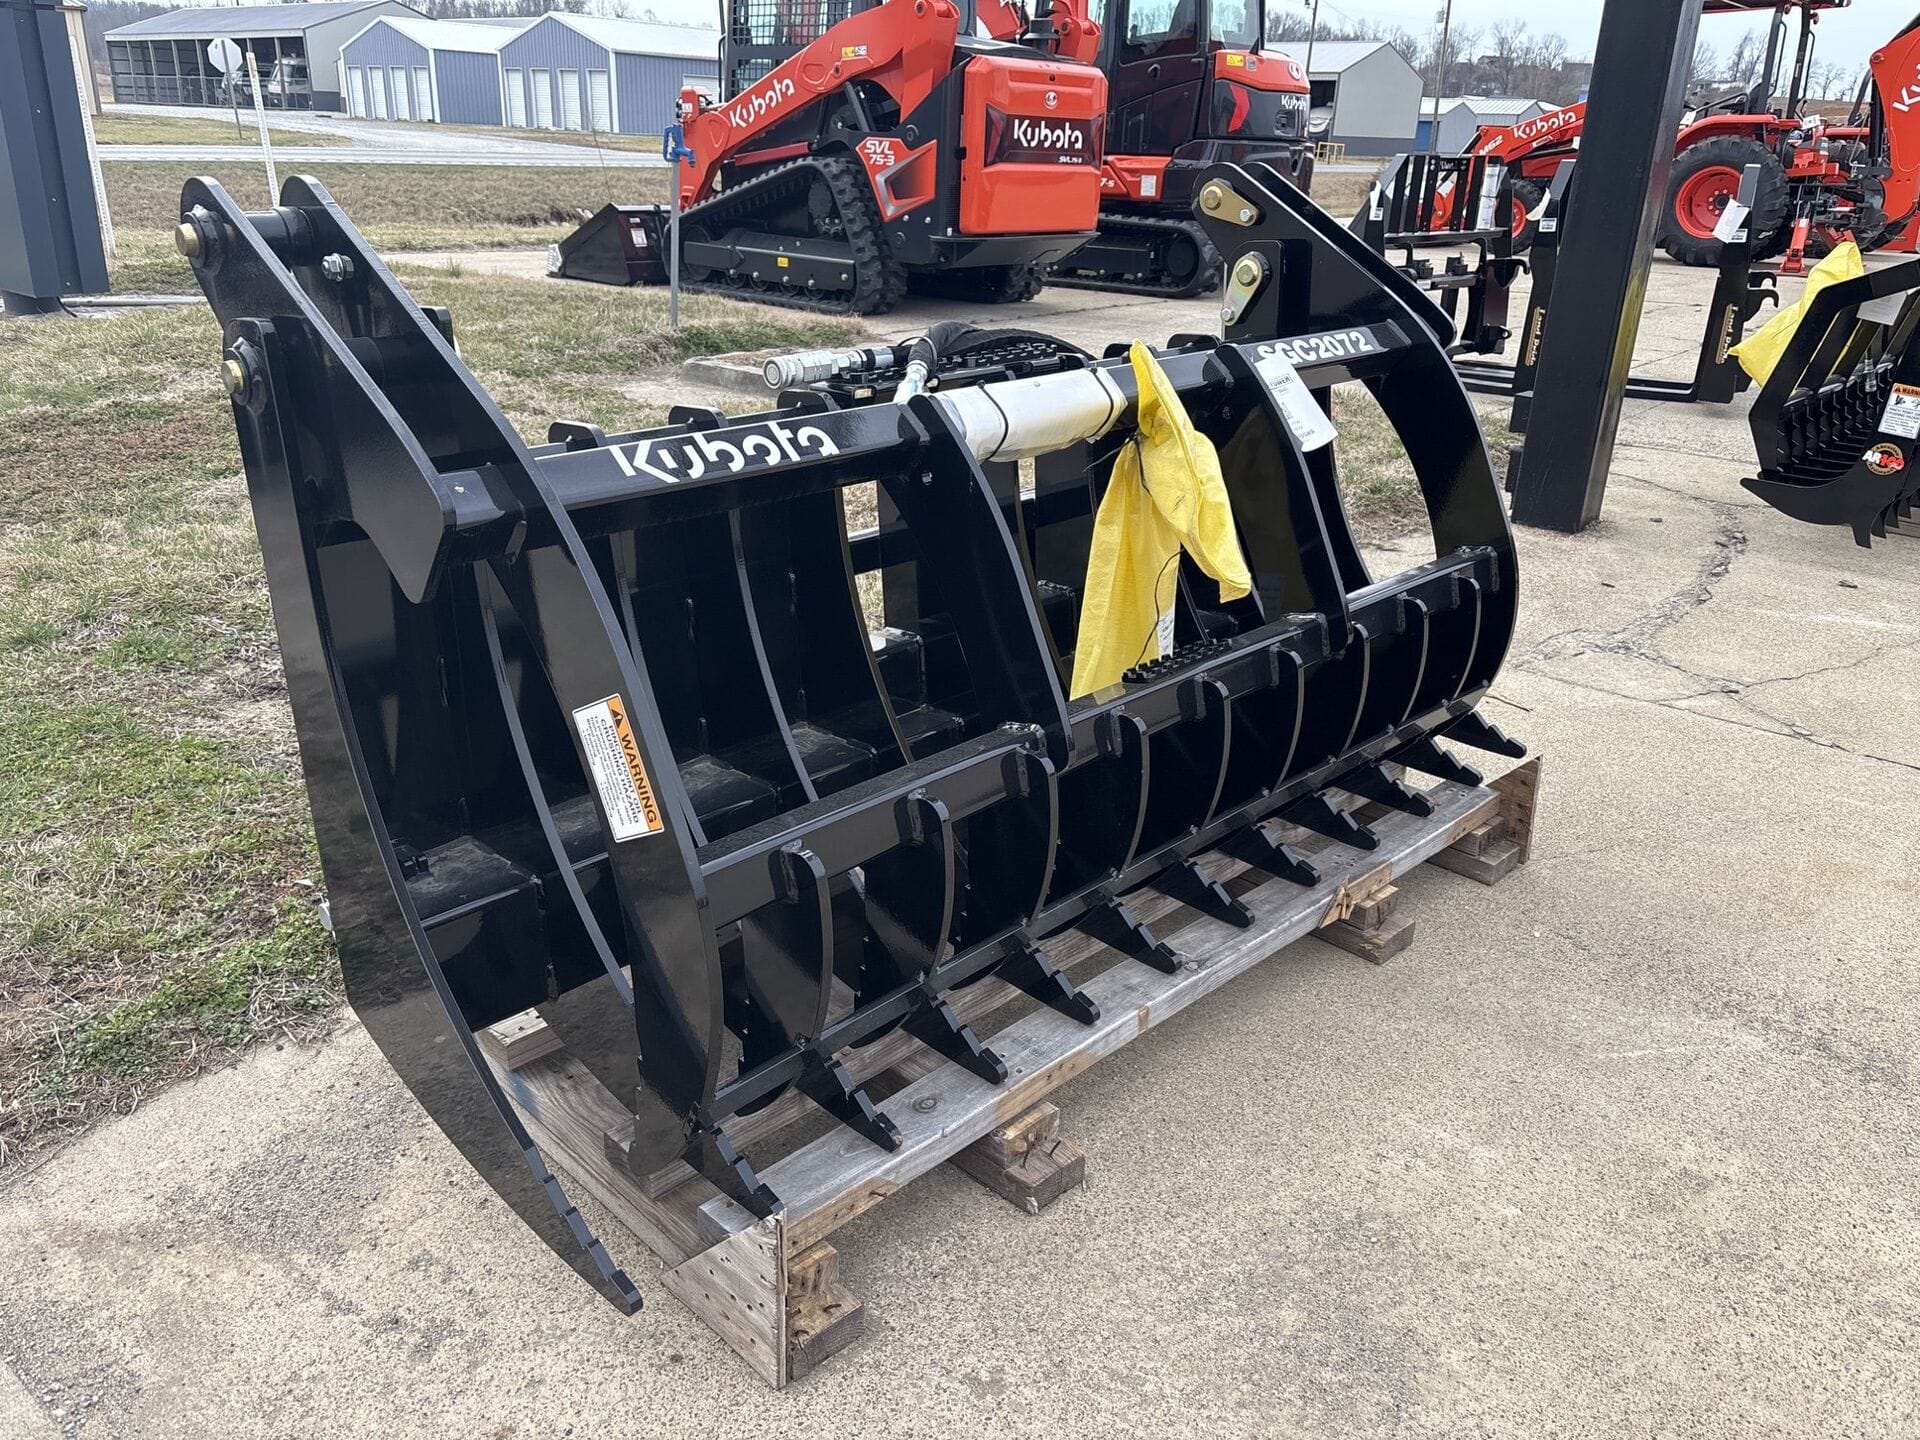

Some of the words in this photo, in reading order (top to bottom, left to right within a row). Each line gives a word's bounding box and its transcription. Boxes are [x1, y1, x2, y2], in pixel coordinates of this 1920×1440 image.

[729, 78, 795, 128] Kubota
[1013, 118, 1083, 149] Kubota
[1478, 134, 1504, 156] M62
[1513, 111, 1577, 139] Kubota
[864, 140, 894, 154] SVL
[869, 154, 895, 166] 75-3
[608, 420, 840, 484] Kubota
[599, 717, 624, 777] CRUSHING
[619, 777, 639, 824] HAZARD
[607, 724, 623, 760] PINCH
[619, 761, 635, 795] POINT
[631, 796, 641, 814] OR
[621, 733, 657, 823] WARNING
